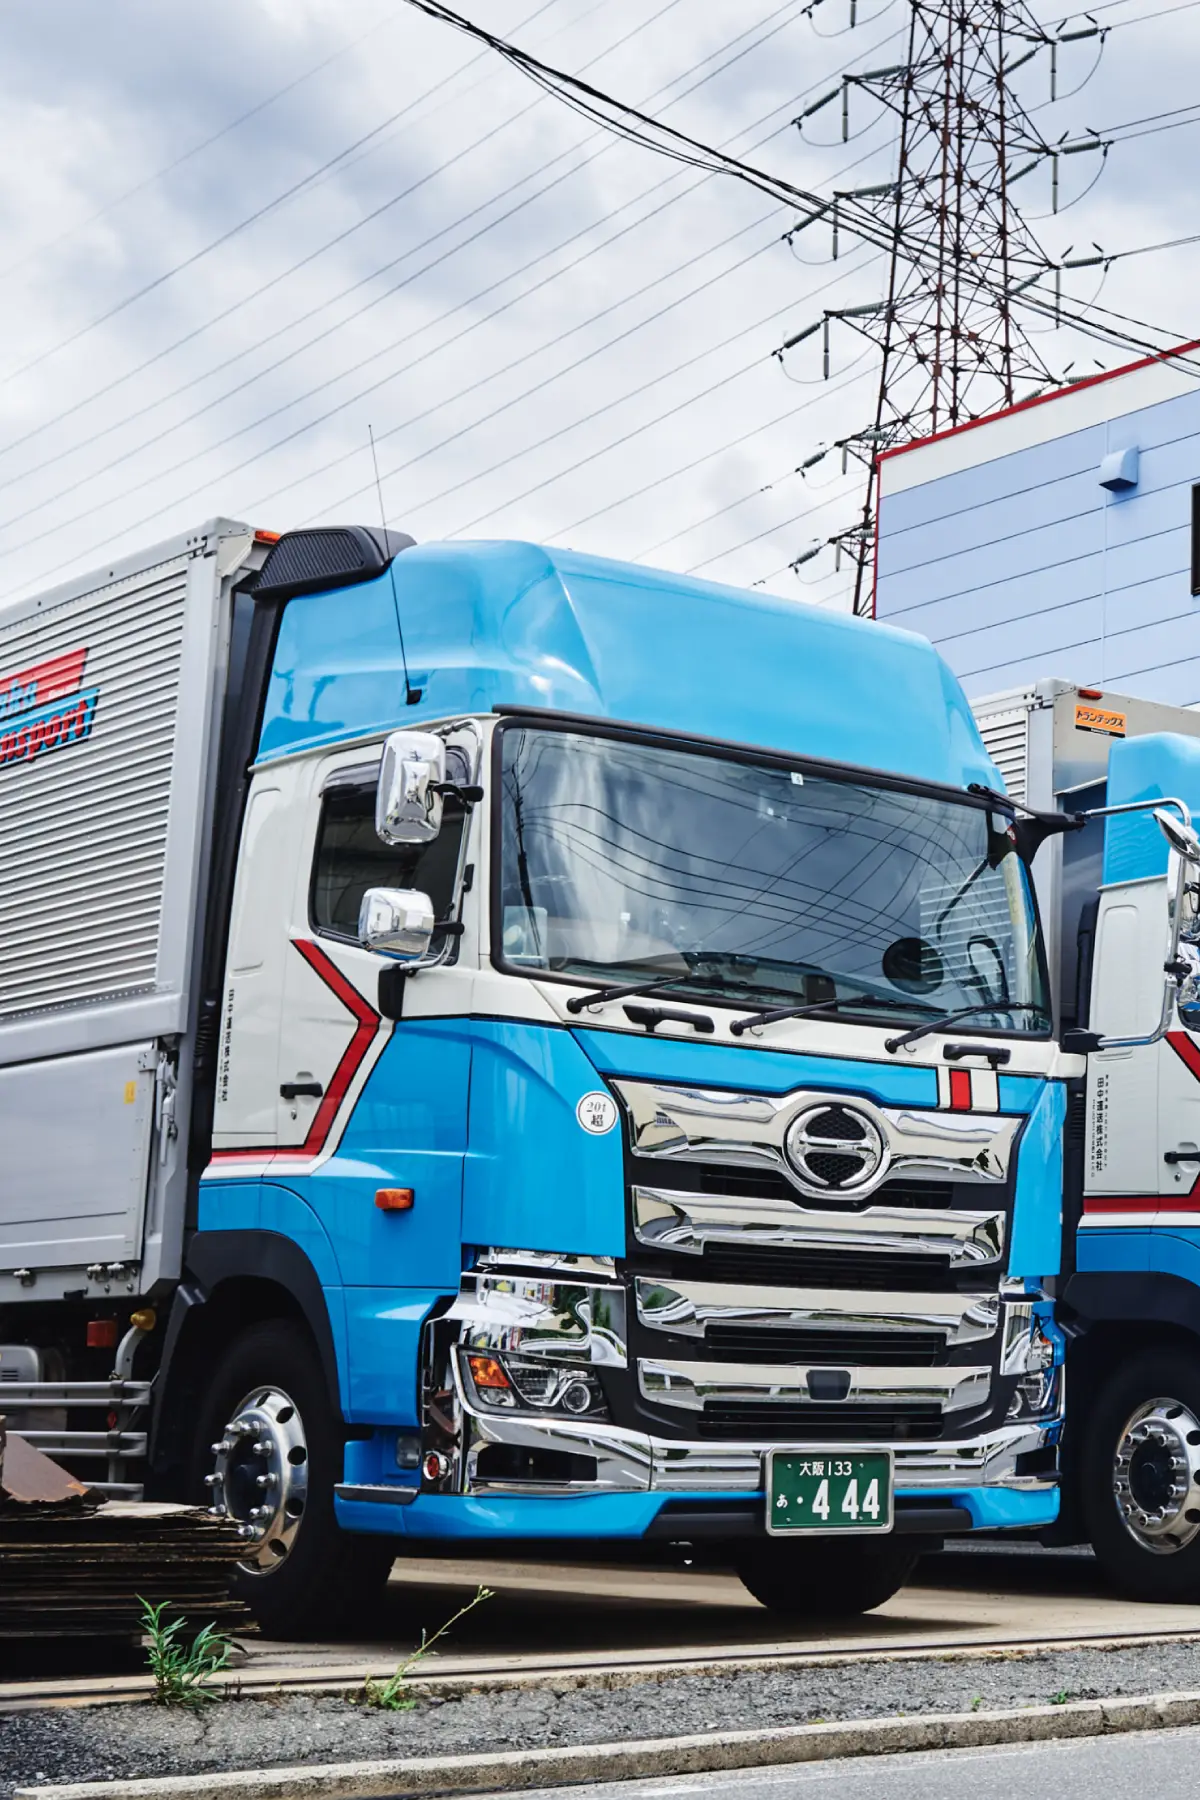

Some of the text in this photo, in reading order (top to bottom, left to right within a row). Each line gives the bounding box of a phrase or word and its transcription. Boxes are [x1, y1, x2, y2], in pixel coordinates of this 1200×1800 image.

[1076, 710, 1124, 727] トランテックス
[776, 1493, 788, 1509] あ
